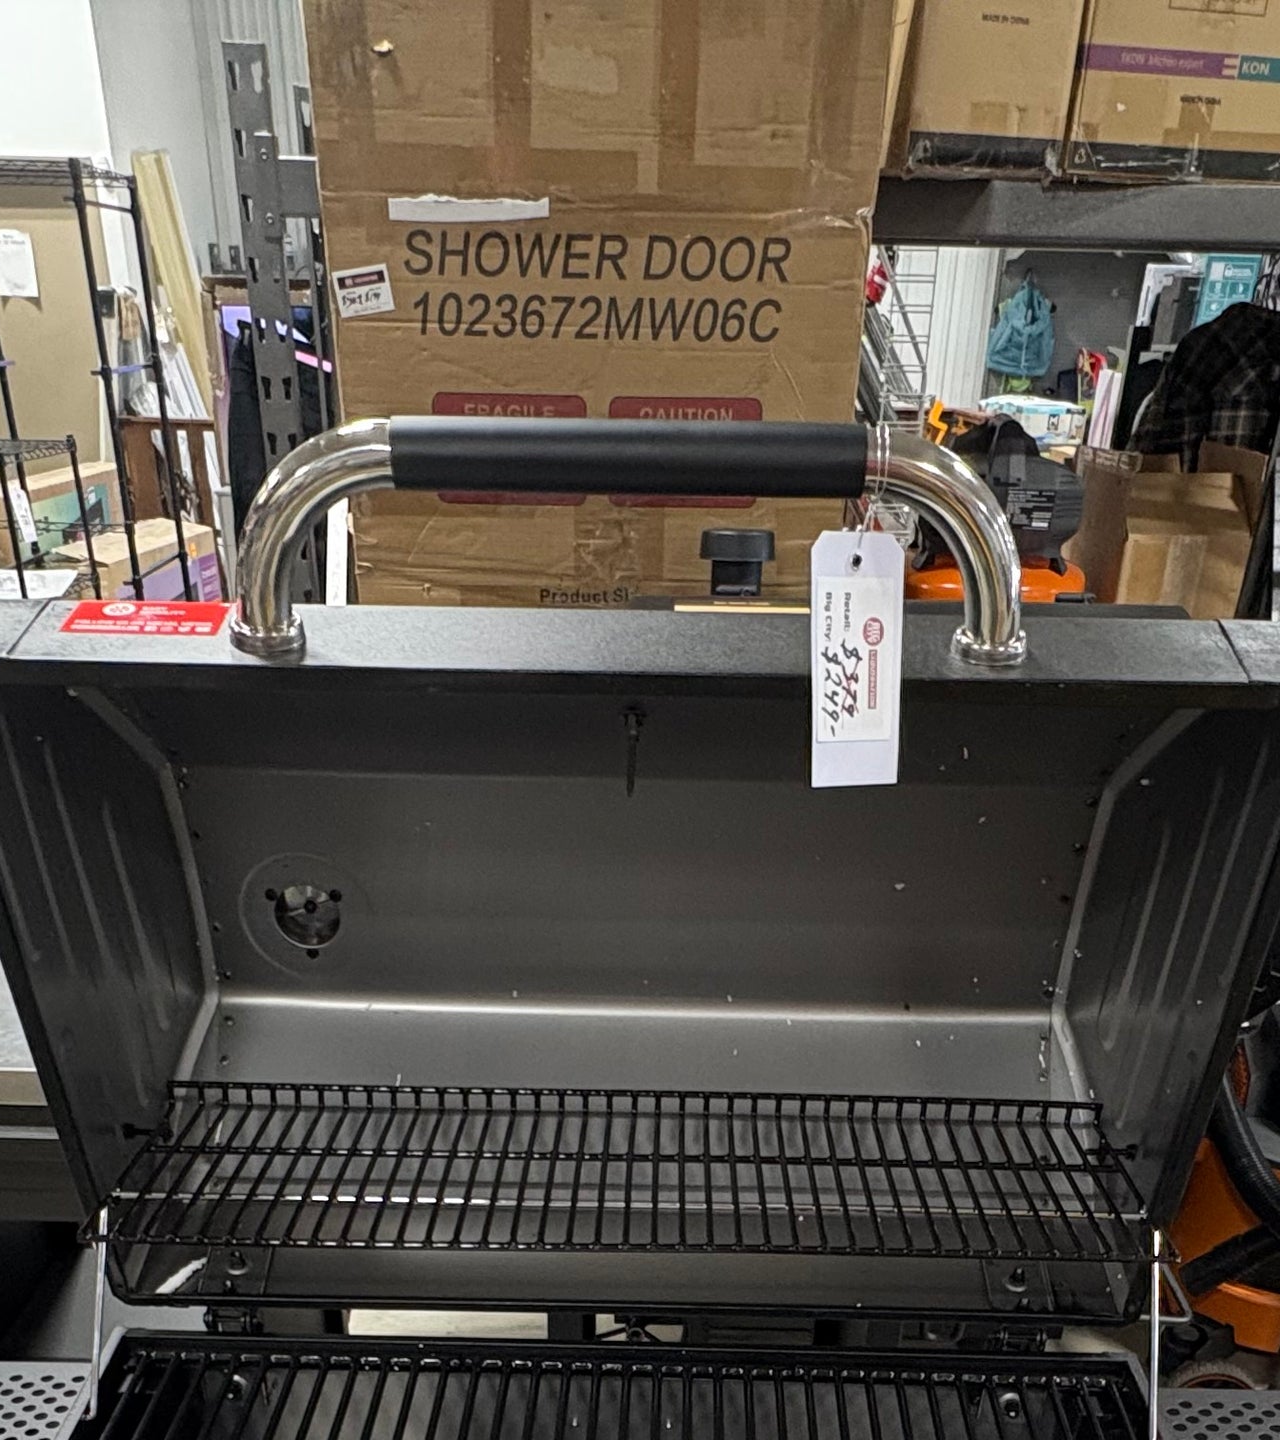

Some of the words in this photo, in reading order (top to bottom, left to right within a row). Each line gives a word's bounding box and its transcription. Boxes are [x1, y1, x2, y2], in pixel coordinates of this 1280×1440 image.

[403, 229, 629, 281] SHOWER
[643, 234, 792, 283] DOOR
[413, 291, 783, 343] 1023672MW06C
[539, 586, 609, 604] Product
[824, 591, 833, 613] Big
